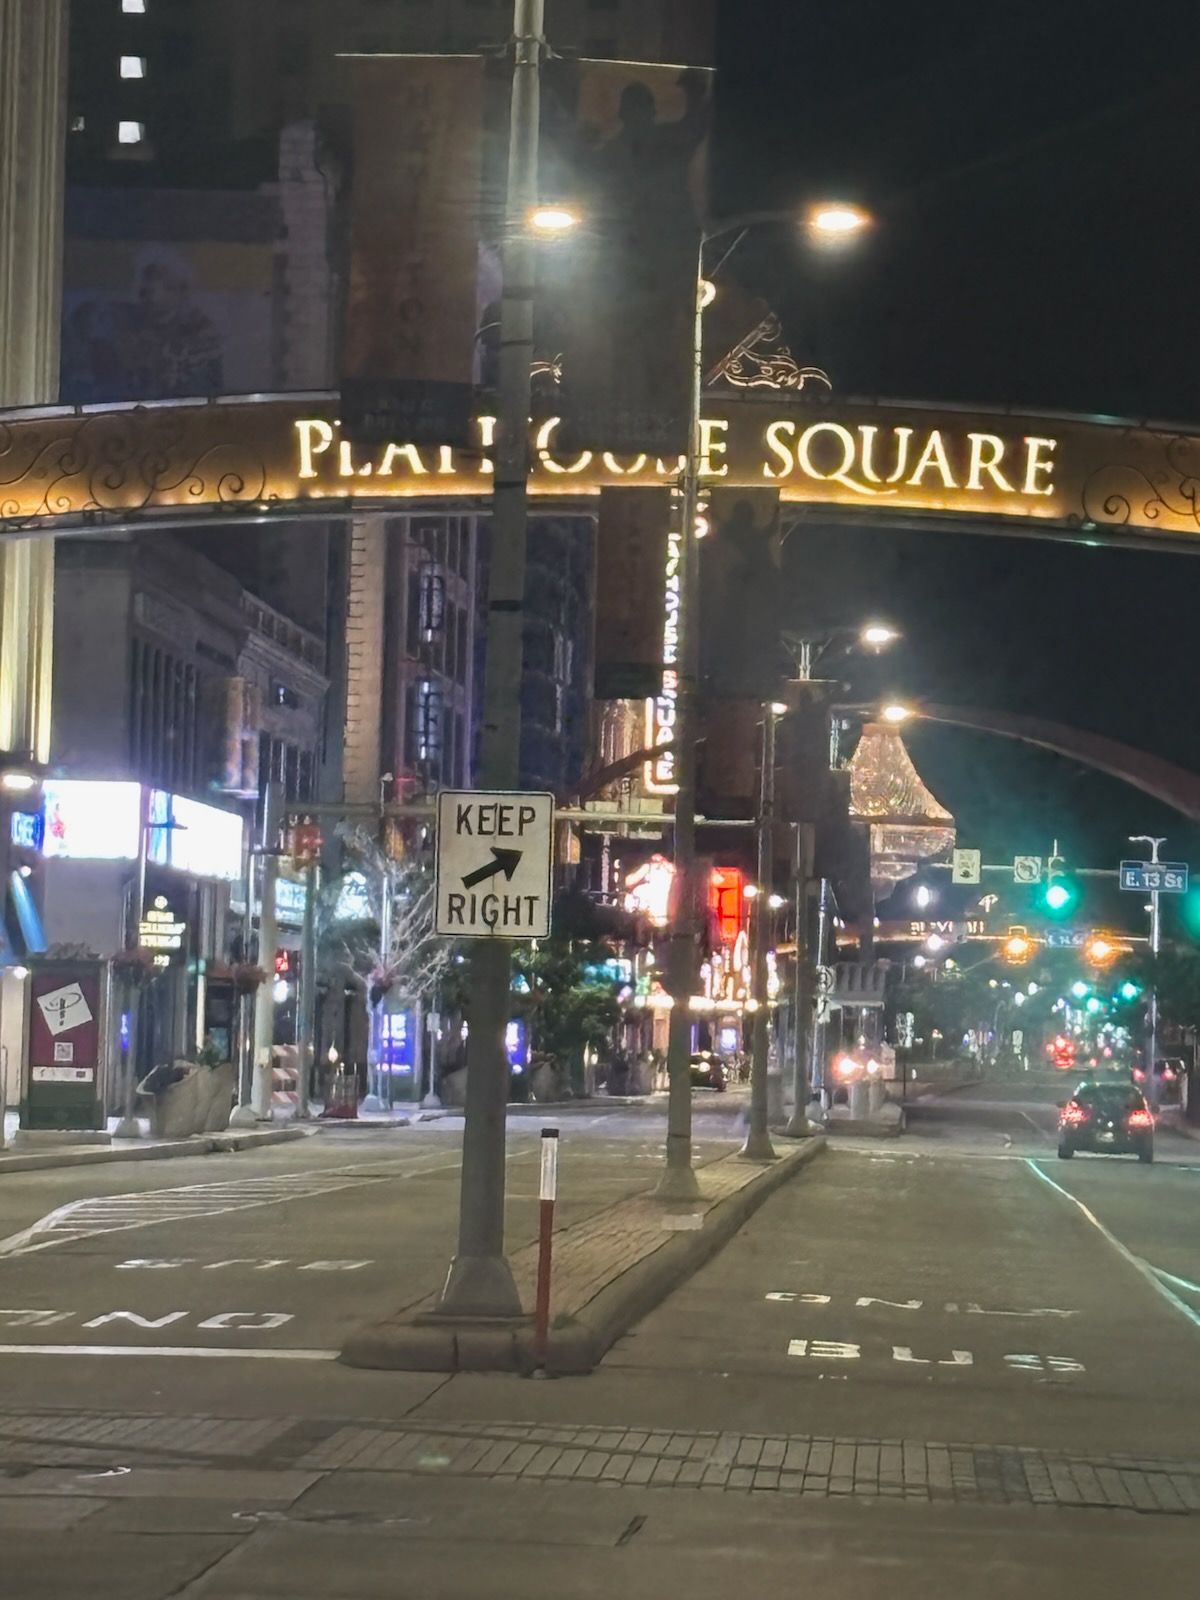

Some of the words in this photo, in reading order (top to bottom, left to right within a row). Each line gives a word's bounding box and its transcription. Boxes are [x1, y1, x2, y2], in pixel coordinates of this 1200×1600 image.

[763, 420, 1058, 497] SQUARE
[455, 803, 536, 837] KEEP
[1142, 872, 1160, 887] 13
[448, 895, 540, 927] RIGHT
[788, 1339, 1087, 1373] BUS
